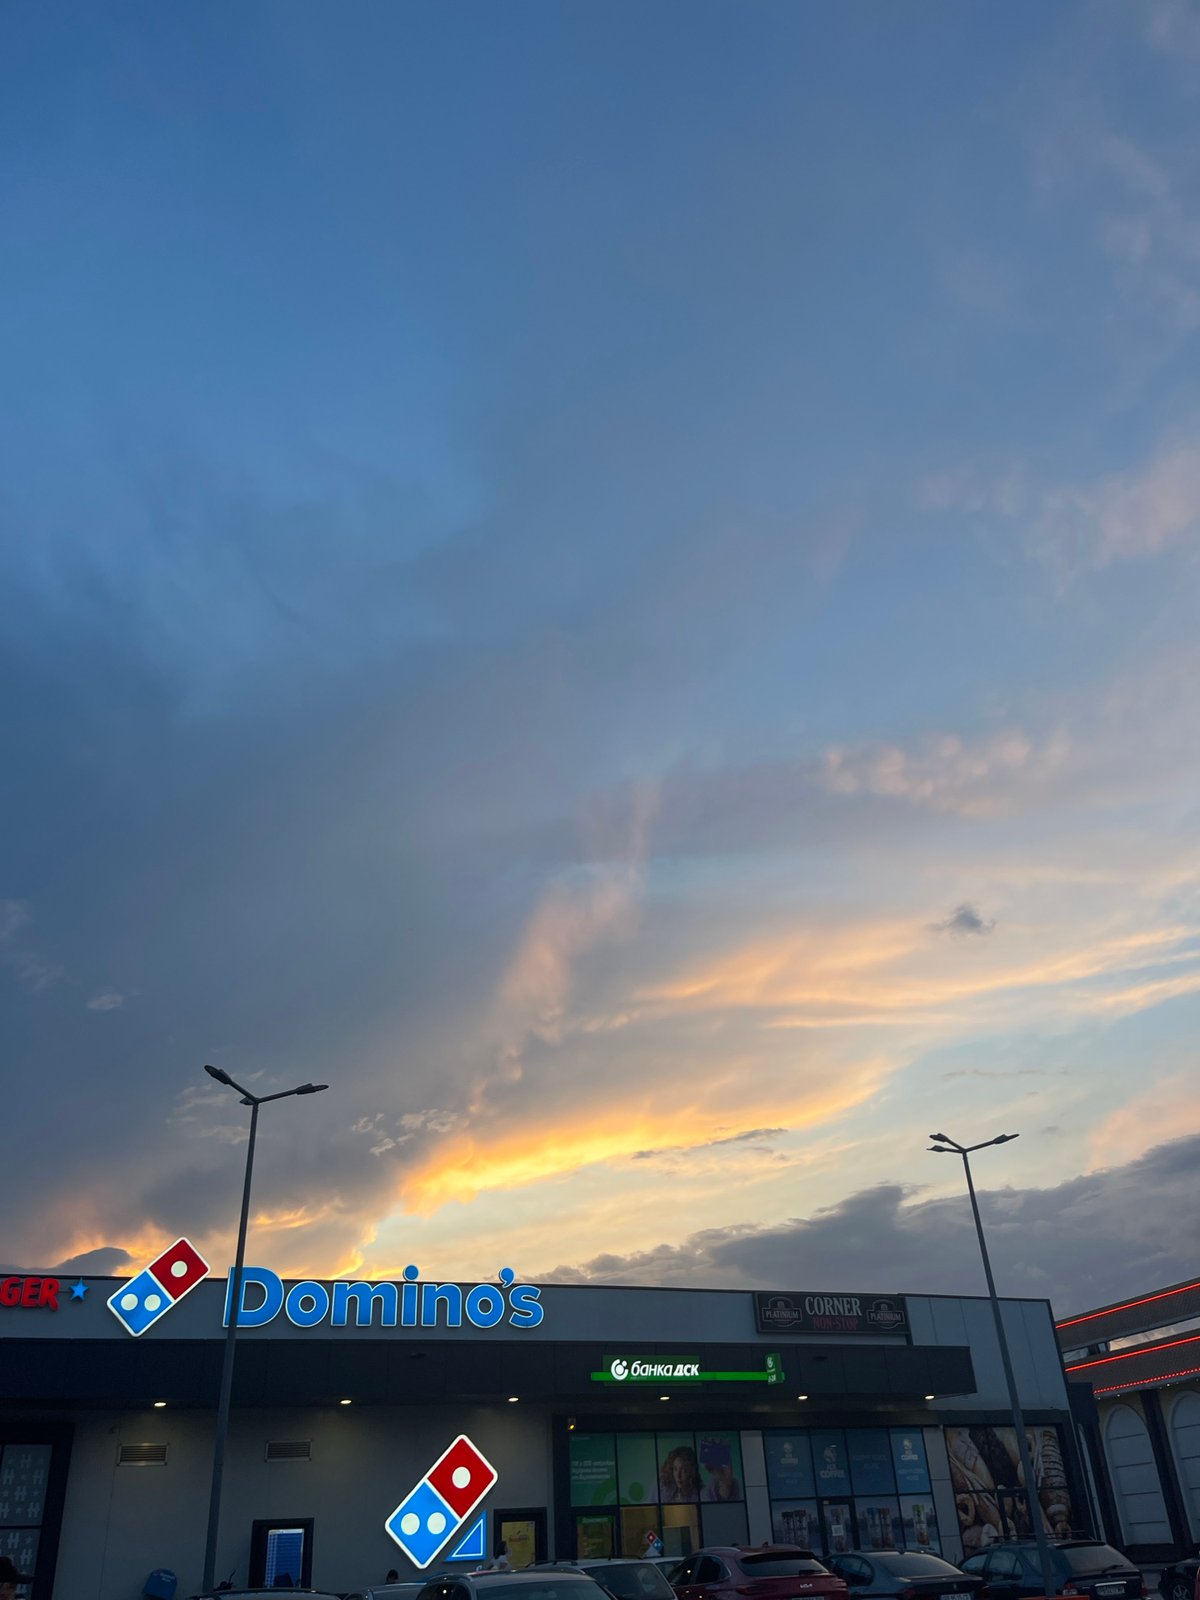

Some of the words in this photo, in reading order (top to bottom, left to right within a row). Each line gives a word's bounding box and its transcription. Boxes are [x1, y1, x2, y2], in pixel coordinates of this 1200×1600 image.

[0, 1277, 60, 1312] GER
[222, 1264, 545, 1329] Domino's
[804, 1296, 863, 1317] CORNER
[812, 1316, 859, 1330] NON-STOP
